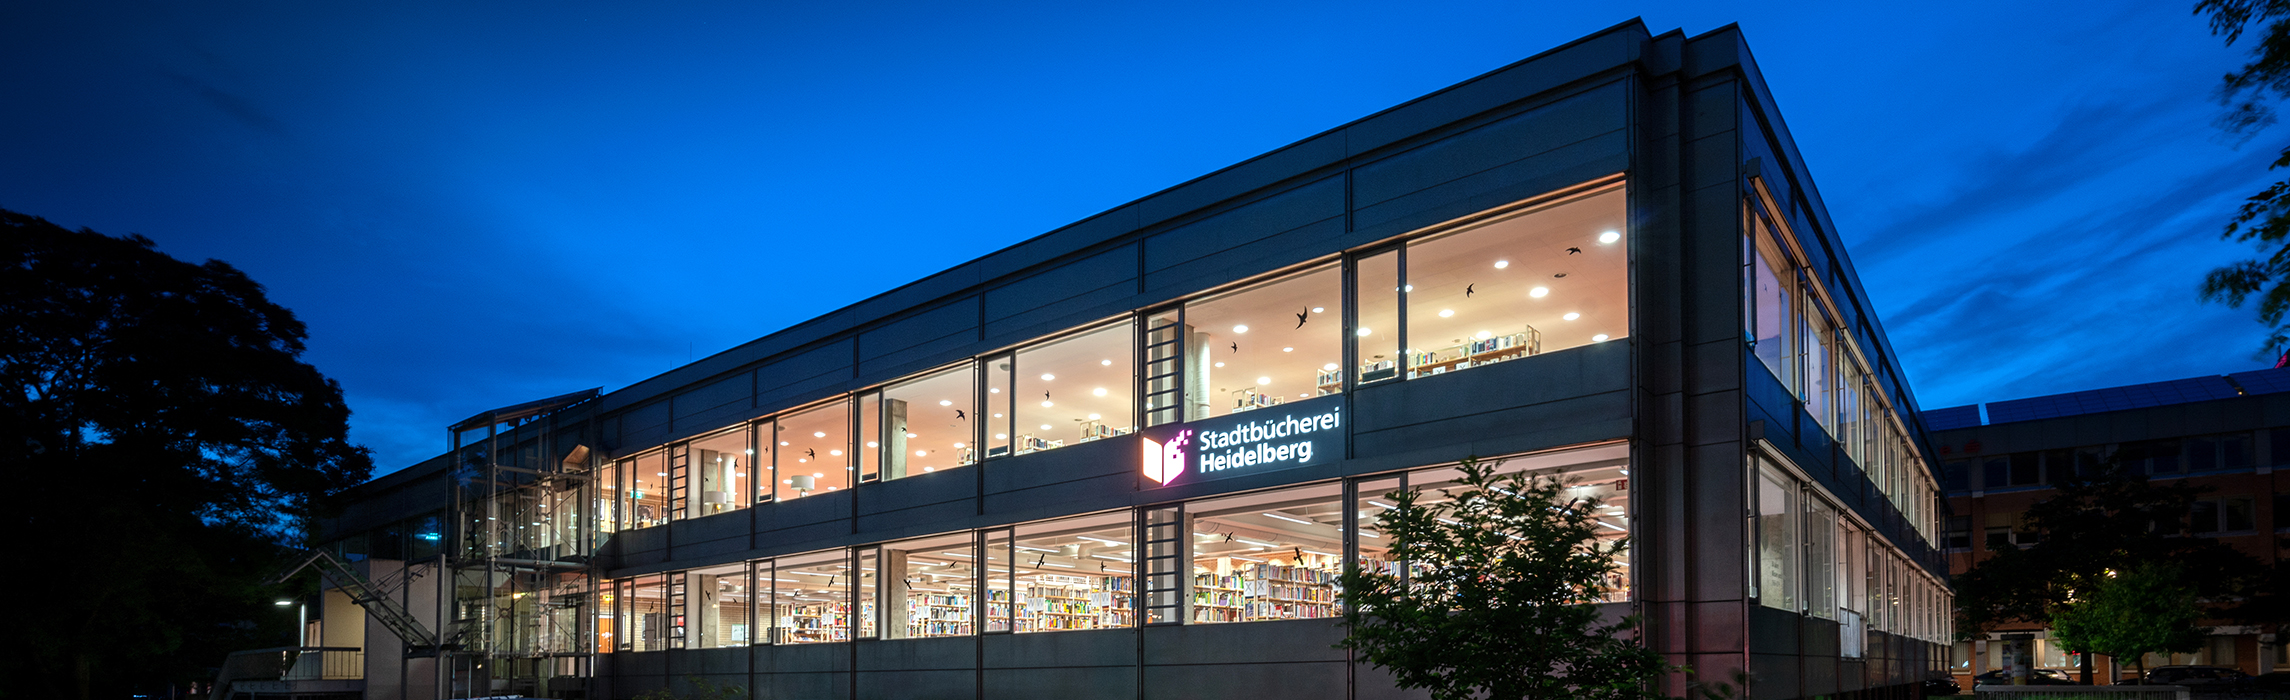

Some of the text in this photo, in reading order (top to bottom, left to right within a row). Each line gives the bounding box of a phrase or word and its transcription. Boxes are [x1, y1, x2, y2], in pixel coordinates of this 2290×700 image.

[1199, 406, 1340, 451] Stadtbücherei
[1200, 440, 1313, 473] Heidelberg
[1245, 582, 1252, 592] X
[1258, 581, 1265, 591] X
